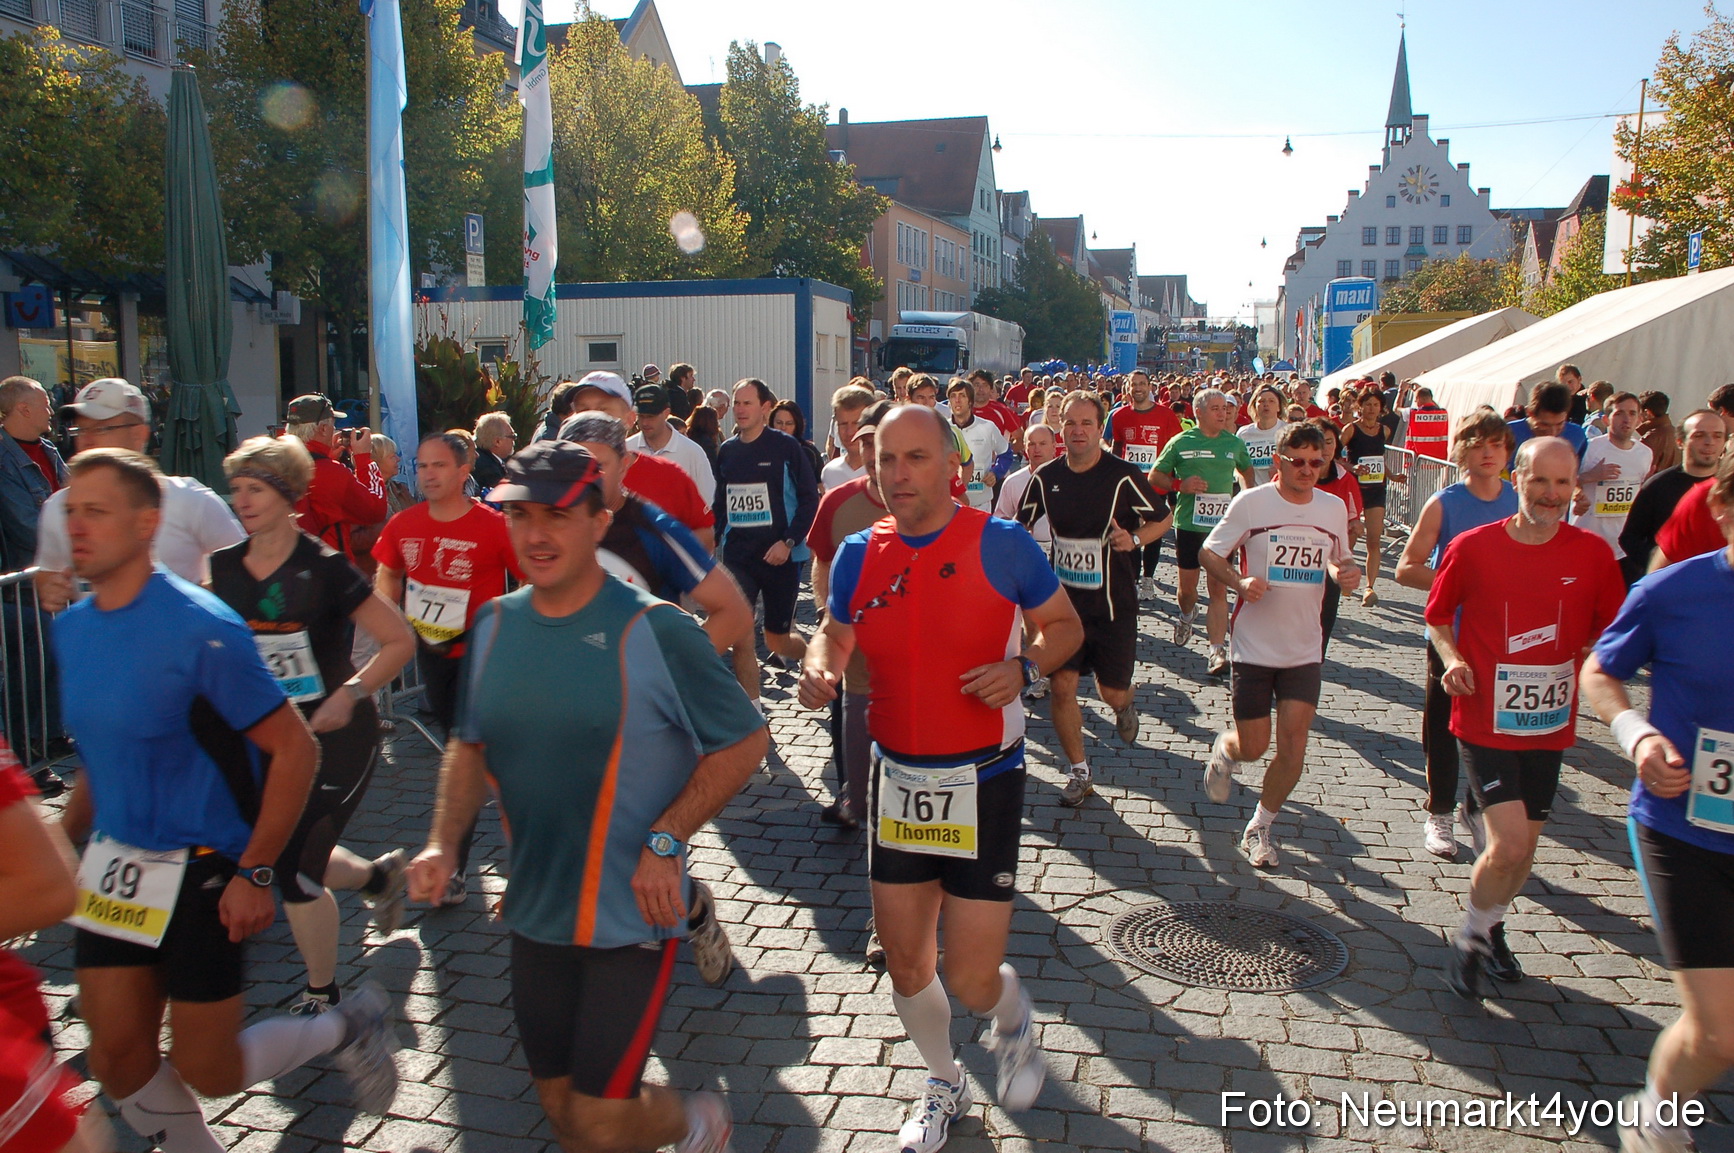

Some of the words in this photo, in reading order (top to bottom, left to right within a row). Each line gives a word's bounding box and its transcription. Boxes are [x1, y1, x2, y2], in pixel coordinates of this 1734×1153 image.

[469, 218, 479, 247] P
[1691, 237, 1698, 264] P
[1335, 286, 1371, 306] maxi
[1112, 317, 1132, 330] axi
[1119, 334, 1129, 342] dsl
[1128, 451, 1152, 463] 2187
[730, 494, 764, 512] 2495
[1606, 487, 1633, 502] 656
[731, 511, 766, 523] Bernhard
[1057, 548, 1096, 571] 2429
[1274, 545, 1323, 568] 2754
[1283, 568, 1315, 581] Oliver
[420, 599, 445, 623] 77
[1521, 633, 1543, 645] DEHN
[1509, 671, 1548, 679] PFLEIDERER
[1505, 681, 1568, 711] 2543
[1515, 712, 1560, 727] Walter
[897, 786, 954, 822] 767
[893, 820, 961, 844] Thomas
[101, 856, 142, 899] 89
